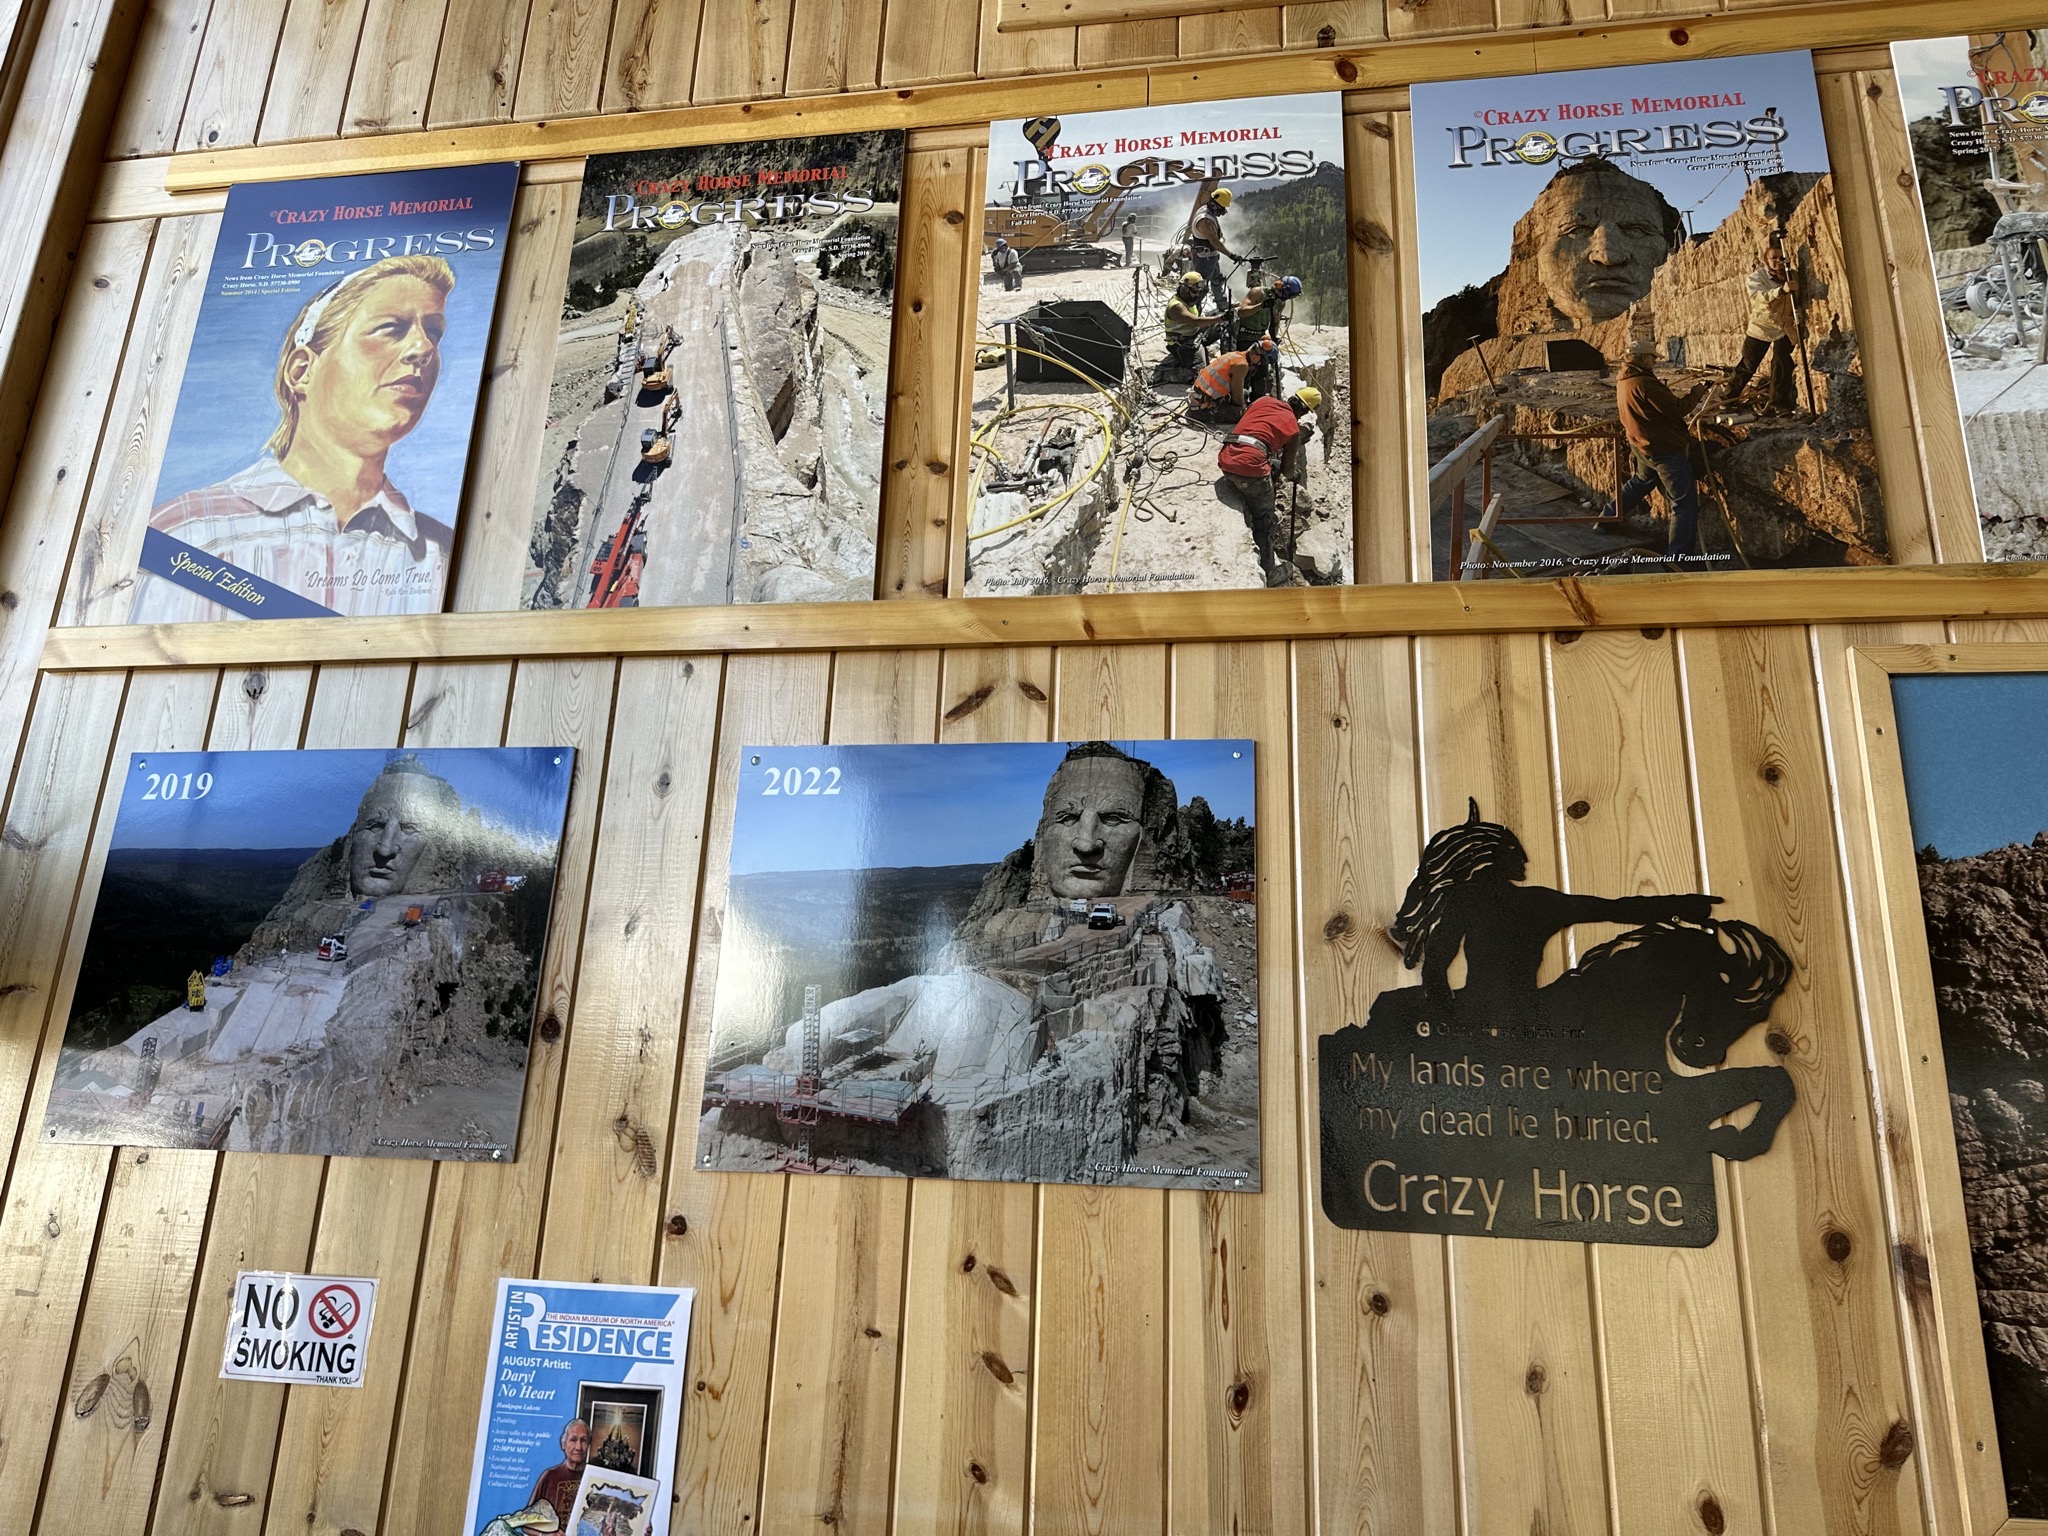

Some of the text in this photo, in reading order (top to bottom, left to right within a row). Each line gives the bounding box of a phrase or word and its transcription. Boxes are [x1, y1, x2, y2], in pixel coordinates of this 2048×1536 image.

[1558, 102, 1624, 120] HORSE
[1631, 92, 1746, 115] MEMORIAL
[1115, 136, 1174, 154] HORSE
[1180, 126, 1283, 147] MEMORIAL
[1445, 116, 1789, 169] PROGRESS
[1952, 148, 1979, 156] Spring
[697, 174, 751, 192] HORSE
[757, 165, 849, 188] MEMORIAL
[1013, 150, 1318, 198] PROGRESS
[333, 204, 384, 222] HORSE
[388, 197, 474, 216] MEMORIAL
[602, 188, 874, 232] PROGRESS
[240, 227, 496, 270] PROGRESS
[1460, 560, 1490, 570] Photo:
[1491, 559, 1538, 570] November
[1540, 556, 1565, 568] 2016,
[1601, 555, 1629, 566] Horse
[1630, 554, 1676, 564] Memorial
[1678, 552, 1732, 562] Foundation
[170, 552, 266, 606] Special Edition
[350, 569, 368, 592] Do
[370, 568, 402, 587] Come
[1010, 576, 1029, 587] July
[1083, 574, 1106, 584] Horse
[1108, 573, 1147, 582] Memorial
[1149, 572, 1195, 582] Foundation
[141, 772, 214, 800] 2019
[762, 766, 842, 796] 2022
[1350, 1050, 1664, 1095] My lands are where
[1358, 1102, 1659, 1145] my dead lie buried.
[400, 1138, 423, 1147] Horse
[424, 1139, 462, 1148] Memorial
[464, 1140, 508, 1150] Foundation
[1121, 1163, 1149, 1174] Horse
[1150, 1164, 1194, 1176] Memorial
[1196, 1168, 1249, 1179] Foundation
[1363, 1158, 1685, 1232] Crazy Horse
[241, 1283, 300, 1331] NO
[504, 1290, 524, 1350] ARTIST IN
[546, 1313, 558, 1321] THE
[559, 1314, 581, 1322] INDIAN
[581, 1316, 610, 1324] MUSEUM
[620, 1318, 642, 1326] NORTH
[233, 1336, 357, 1374] SMOKING
[502, 1356, 572, 1370] AUGUST Artist:
[316, 1375, 338, 1384] THANK
[500, 1368, 536, 1386] Daryl
[498, 1384, 556, 1400] No Heart
